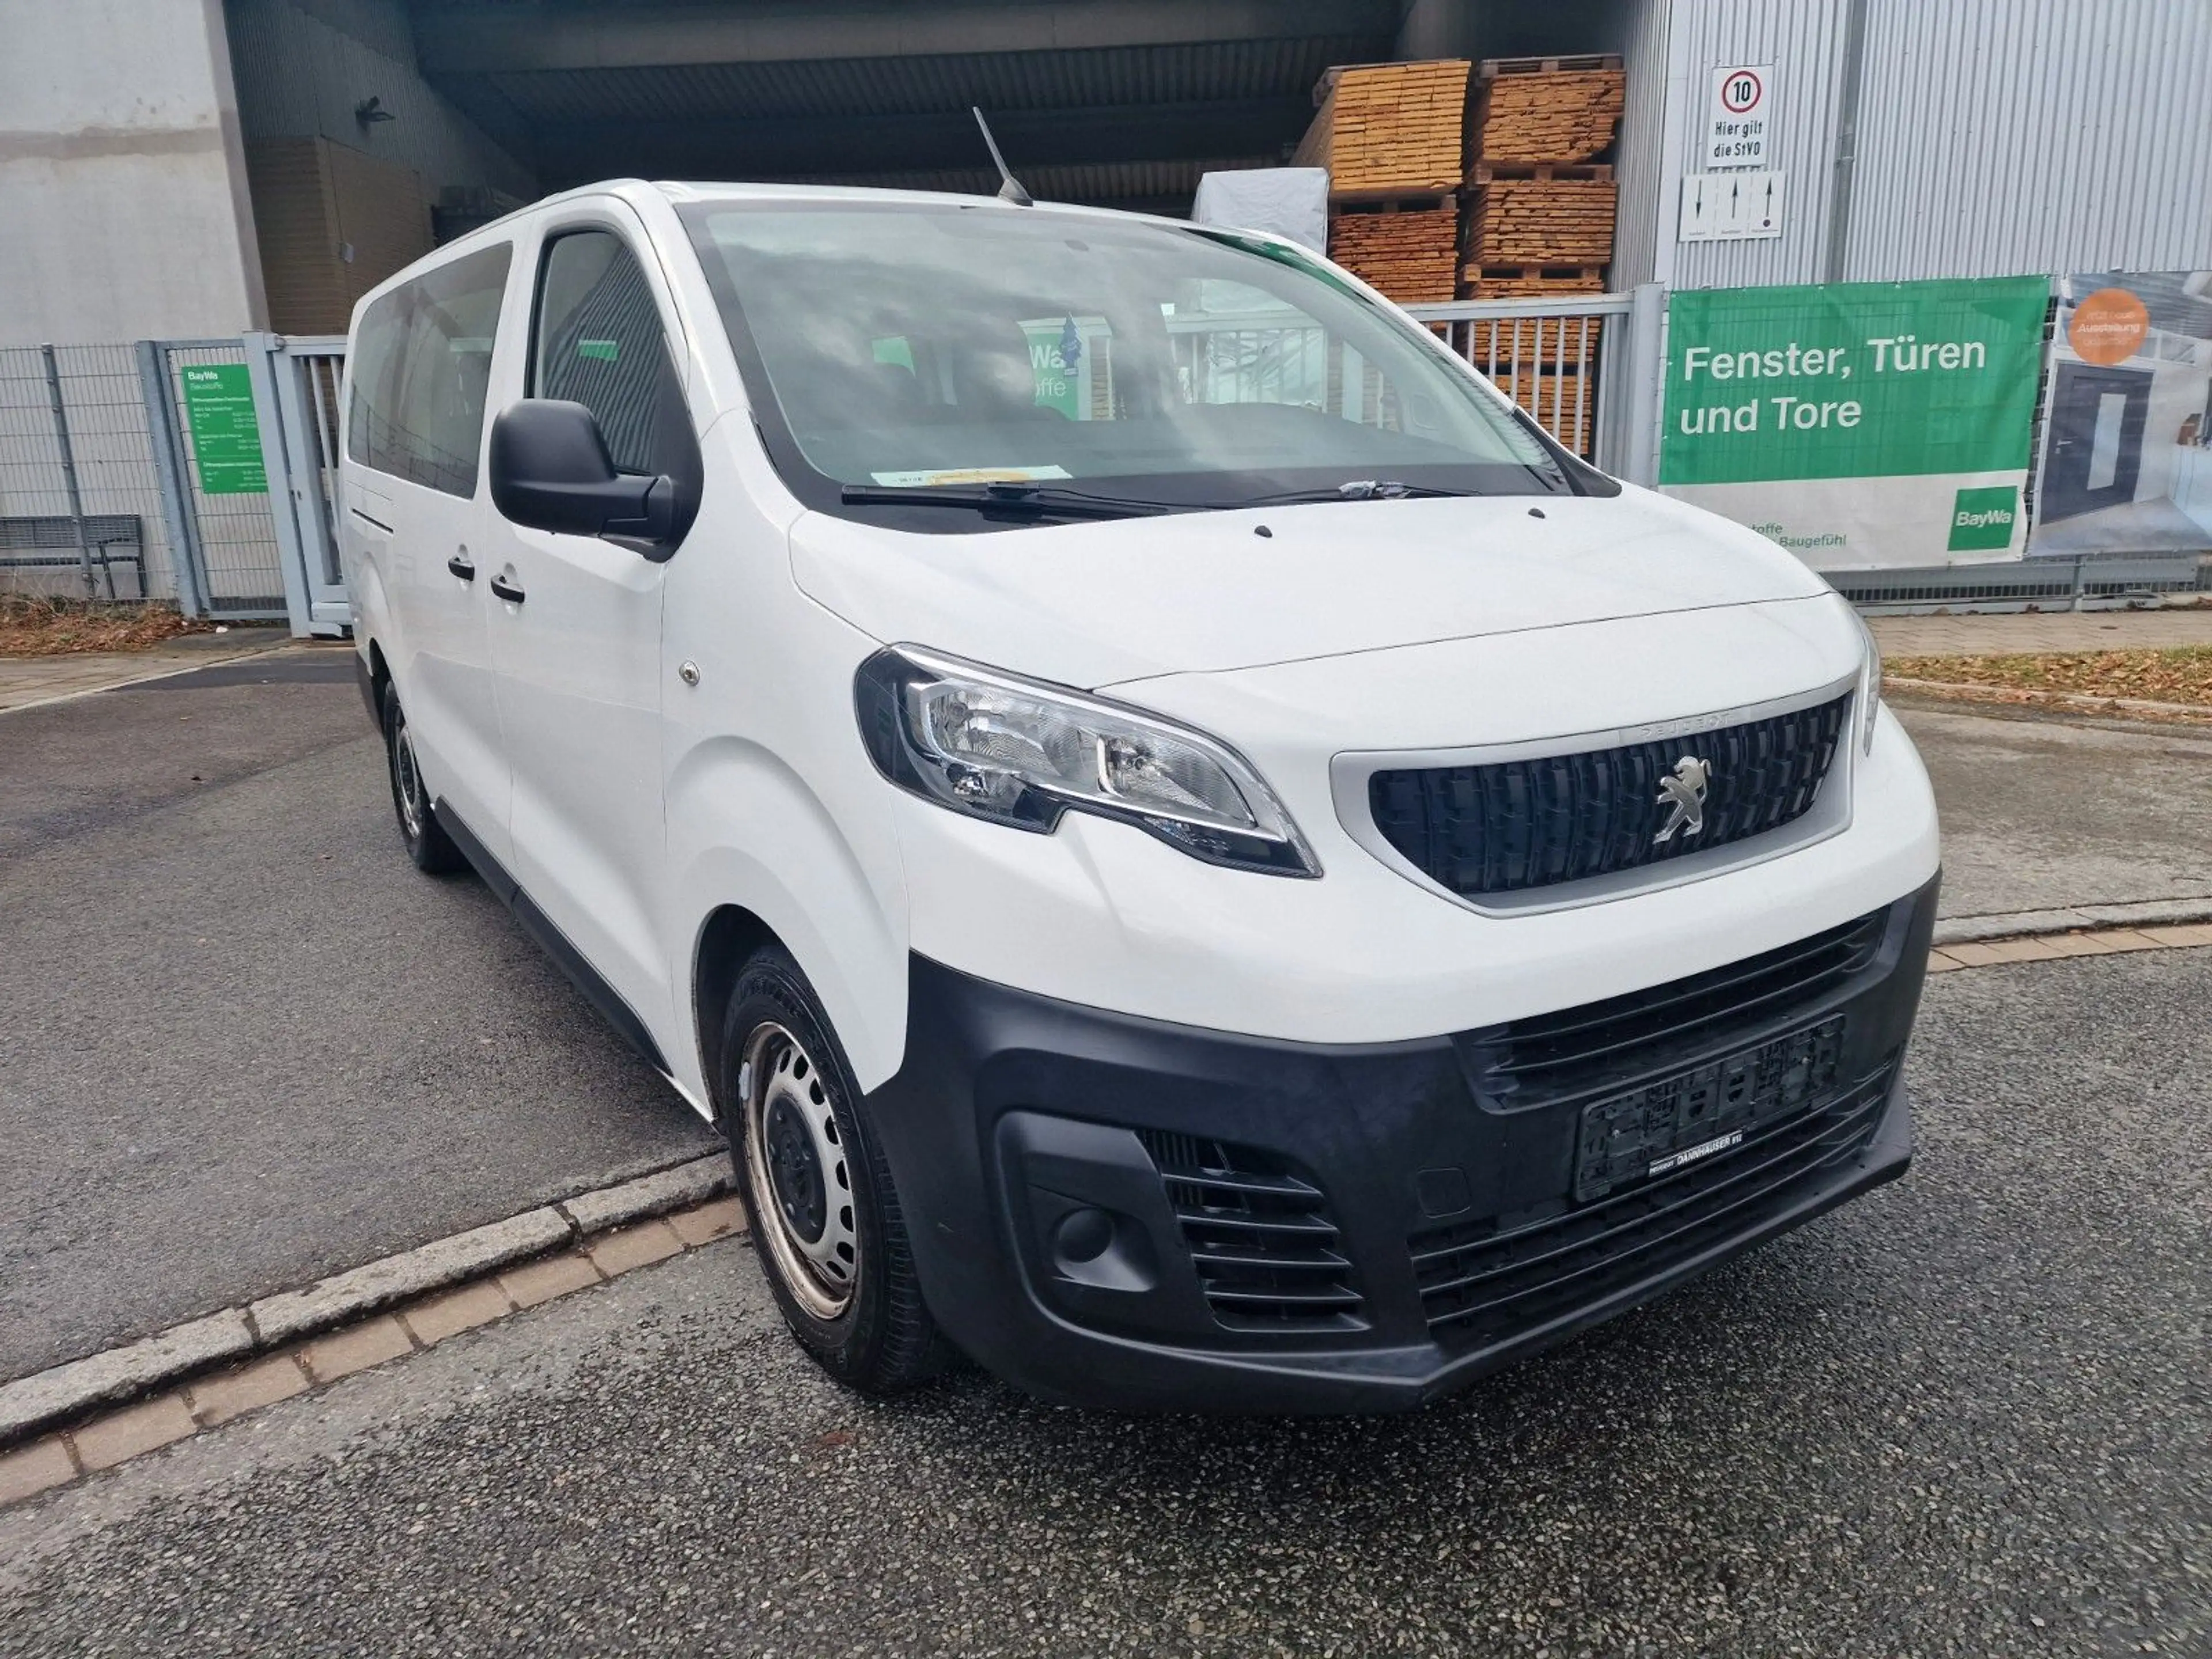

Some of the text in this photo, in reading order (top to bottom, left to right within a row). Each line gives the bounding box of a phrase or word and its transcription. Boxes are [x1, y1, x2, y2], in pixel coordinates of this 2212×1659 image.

[1733, 81, 1751, 103] 10
[1715, 120, 1763, 138] Hier gilt
[1714, 142, 1761, 157] die StVO
[1684, 335, 1986, 381] Fenster, Türen
[1680, 396, 1862, 434] und Tore
[1749, 522, 1783, 534] toffe
[1956, 510, 2012, 528] BayWa
